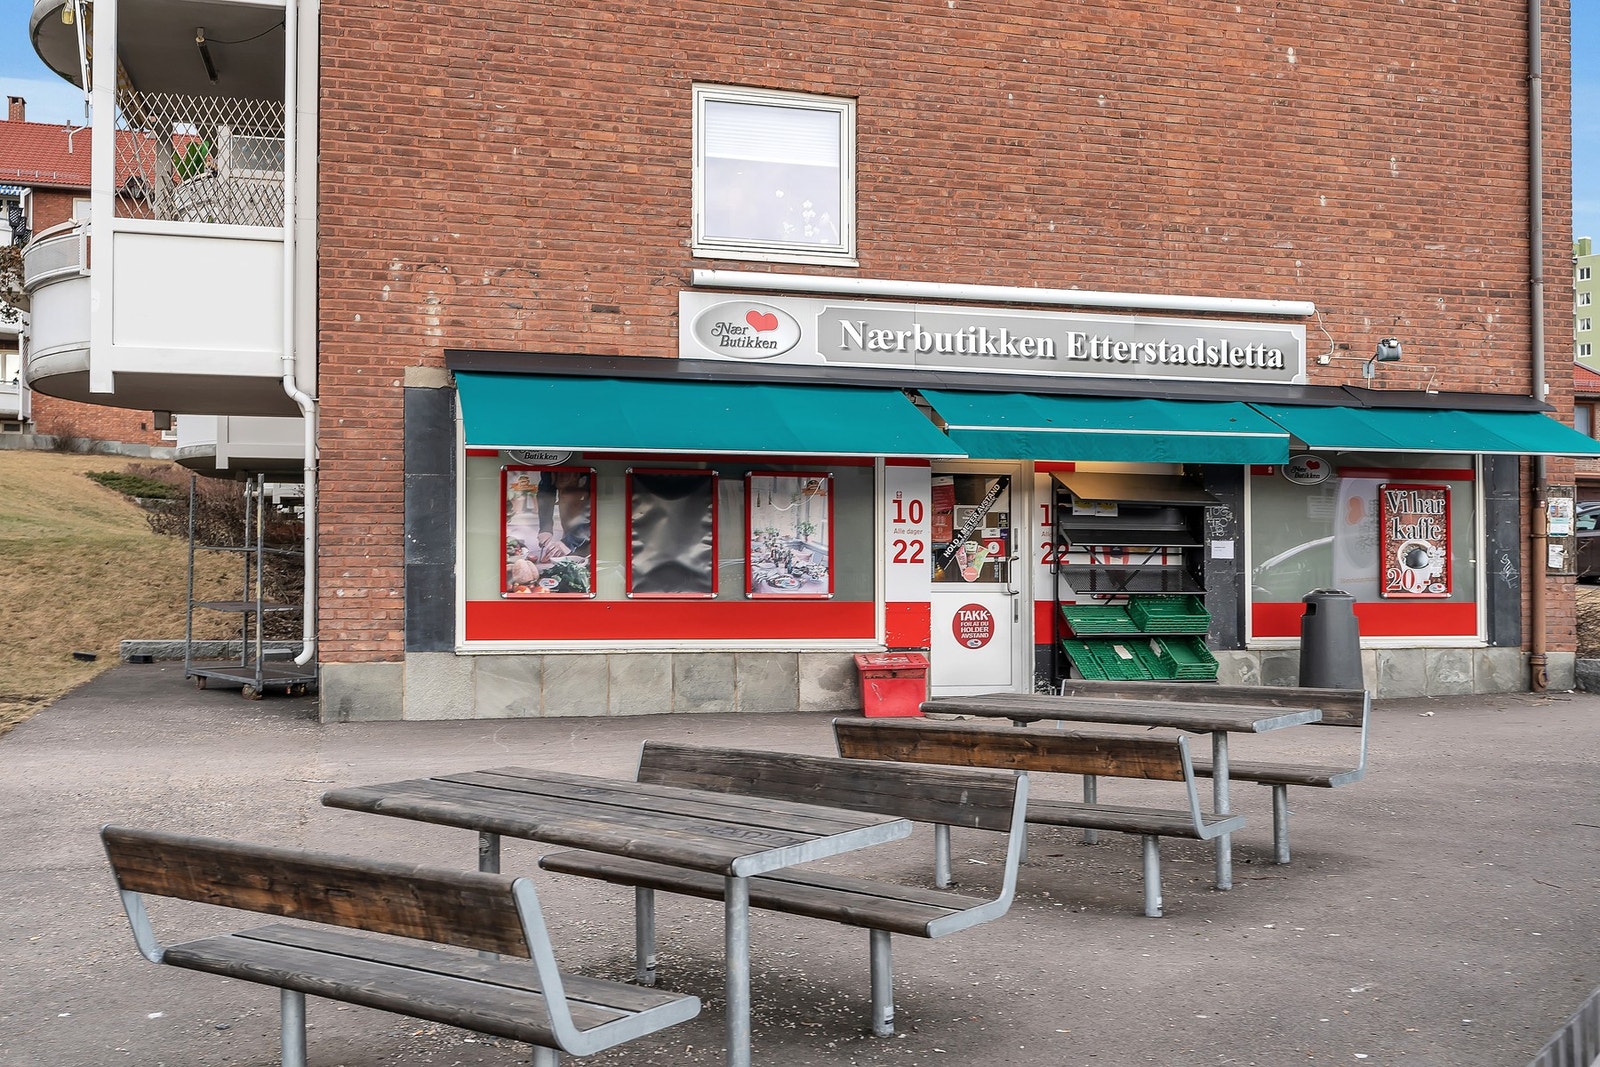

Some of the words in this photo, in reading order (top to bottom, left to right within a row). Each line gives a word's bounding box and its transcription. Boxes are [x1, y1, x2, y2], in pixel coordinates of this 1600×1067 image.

[711, 321, 749, 337] Nær
[719, 334, 778, 349] Butikken
[838, 319, 1056, 358] Nærbutikken
[1065, 331, 1285, 368] Etterstadsletta
[524, 452, 558, 460] Butikken
[892, 499, 923, 524] 10
[1386, 490, 1409, 514] Vi
[1410, 490, 1446, 514] har
[943, 538, 960, 558] HOLD
[960, 512, 980, 535] METER
[977, 484, 1001, 513] AVSTAND
[1391, 517, 1442, 540] kaffe
[893, 539, 924, 563] 22
[1041, 542, 1070, 564] 22
